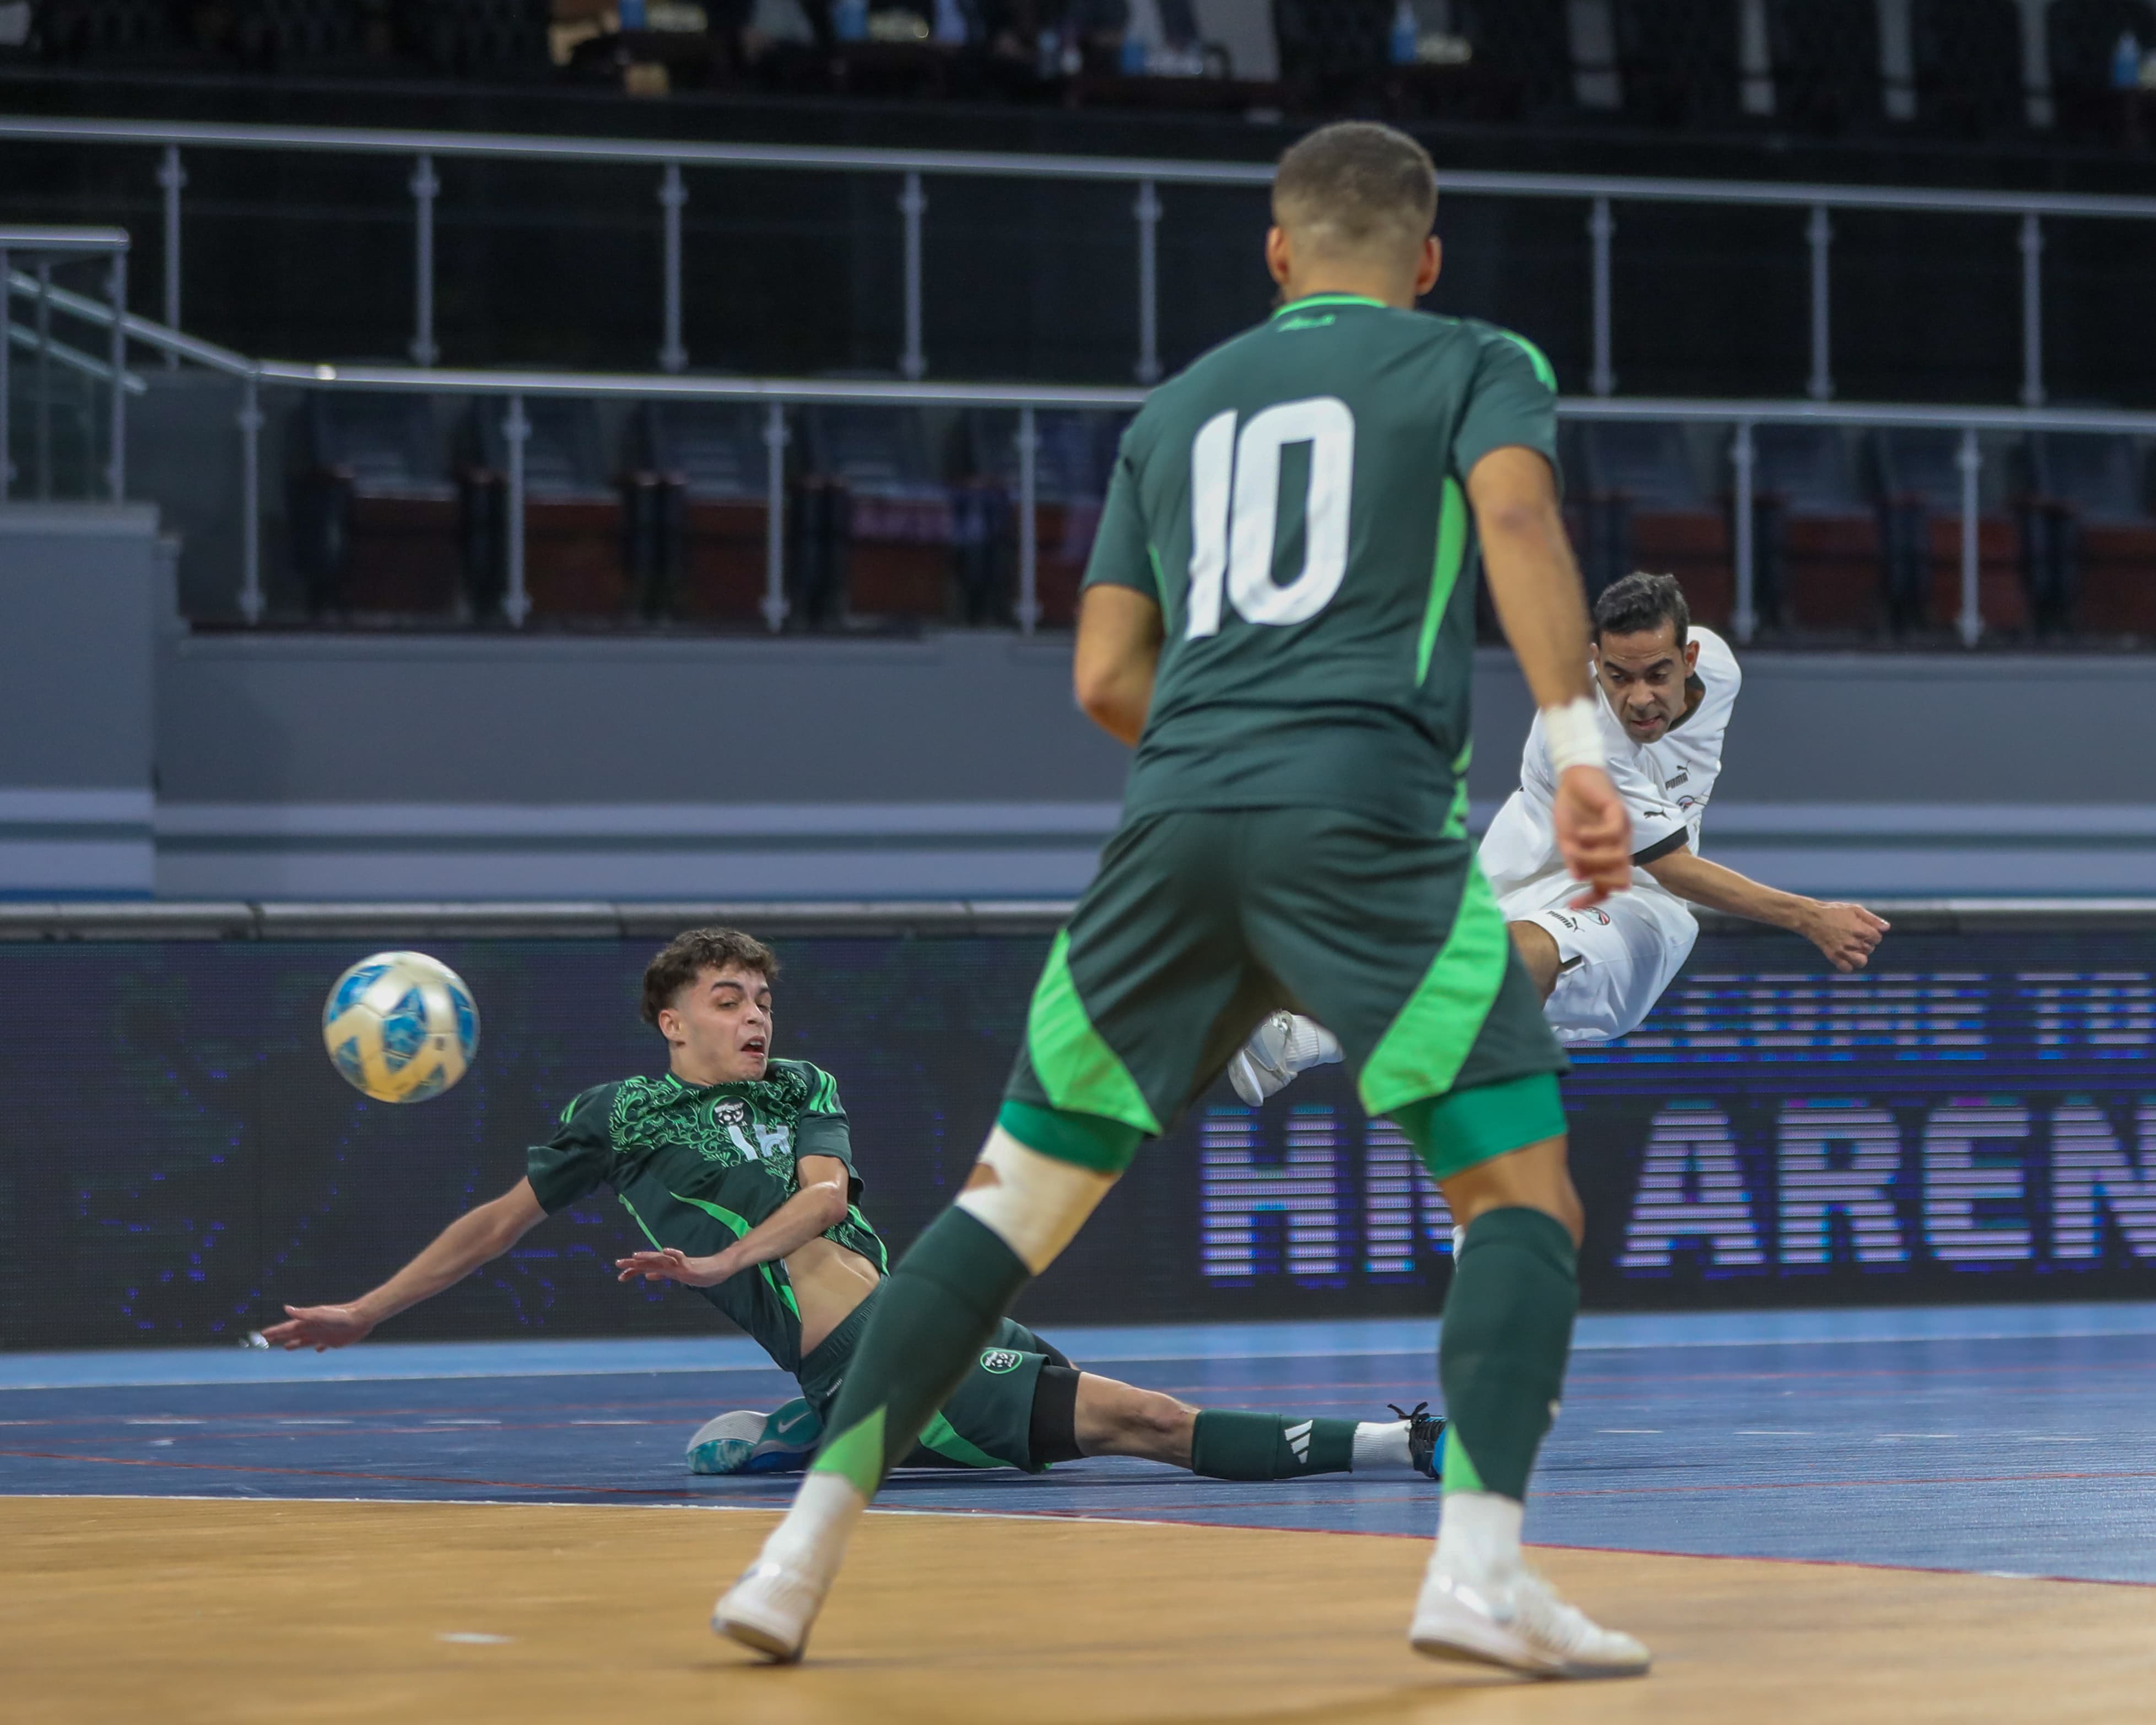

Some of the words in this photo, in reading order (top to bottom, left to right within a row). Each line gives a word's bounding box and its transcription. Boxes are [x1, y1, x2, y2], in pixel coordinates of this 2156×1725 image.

[1185, 396, 1355, 642] 10
[1665, 772, 1689, 791] PUMA
[1546, 910, 1574, 929] PUMA
[1564, 973, 1986, 1061] COME
[2017, 972, 2150, 1060] TO
